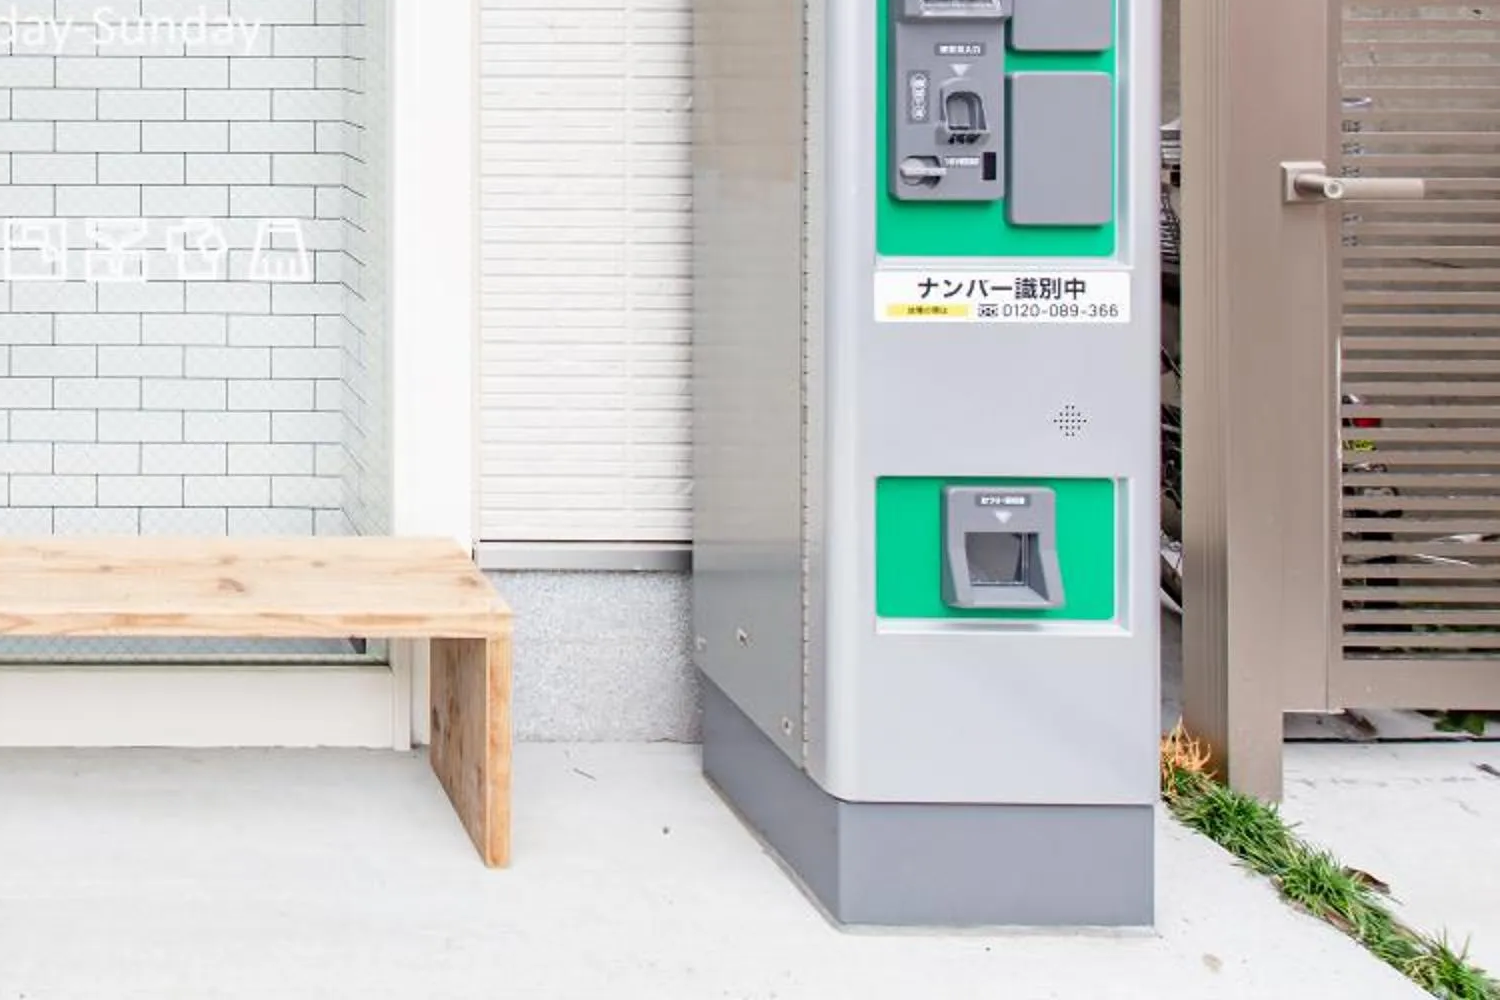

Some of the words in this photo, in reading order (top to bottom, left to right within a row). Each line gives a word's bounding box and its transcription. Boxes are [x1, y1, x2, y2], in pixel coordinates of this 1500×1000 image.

[917, 277, 1086, 301] ナンバー識別中
[1002, 303, 1119, 318] 0120-089-366
